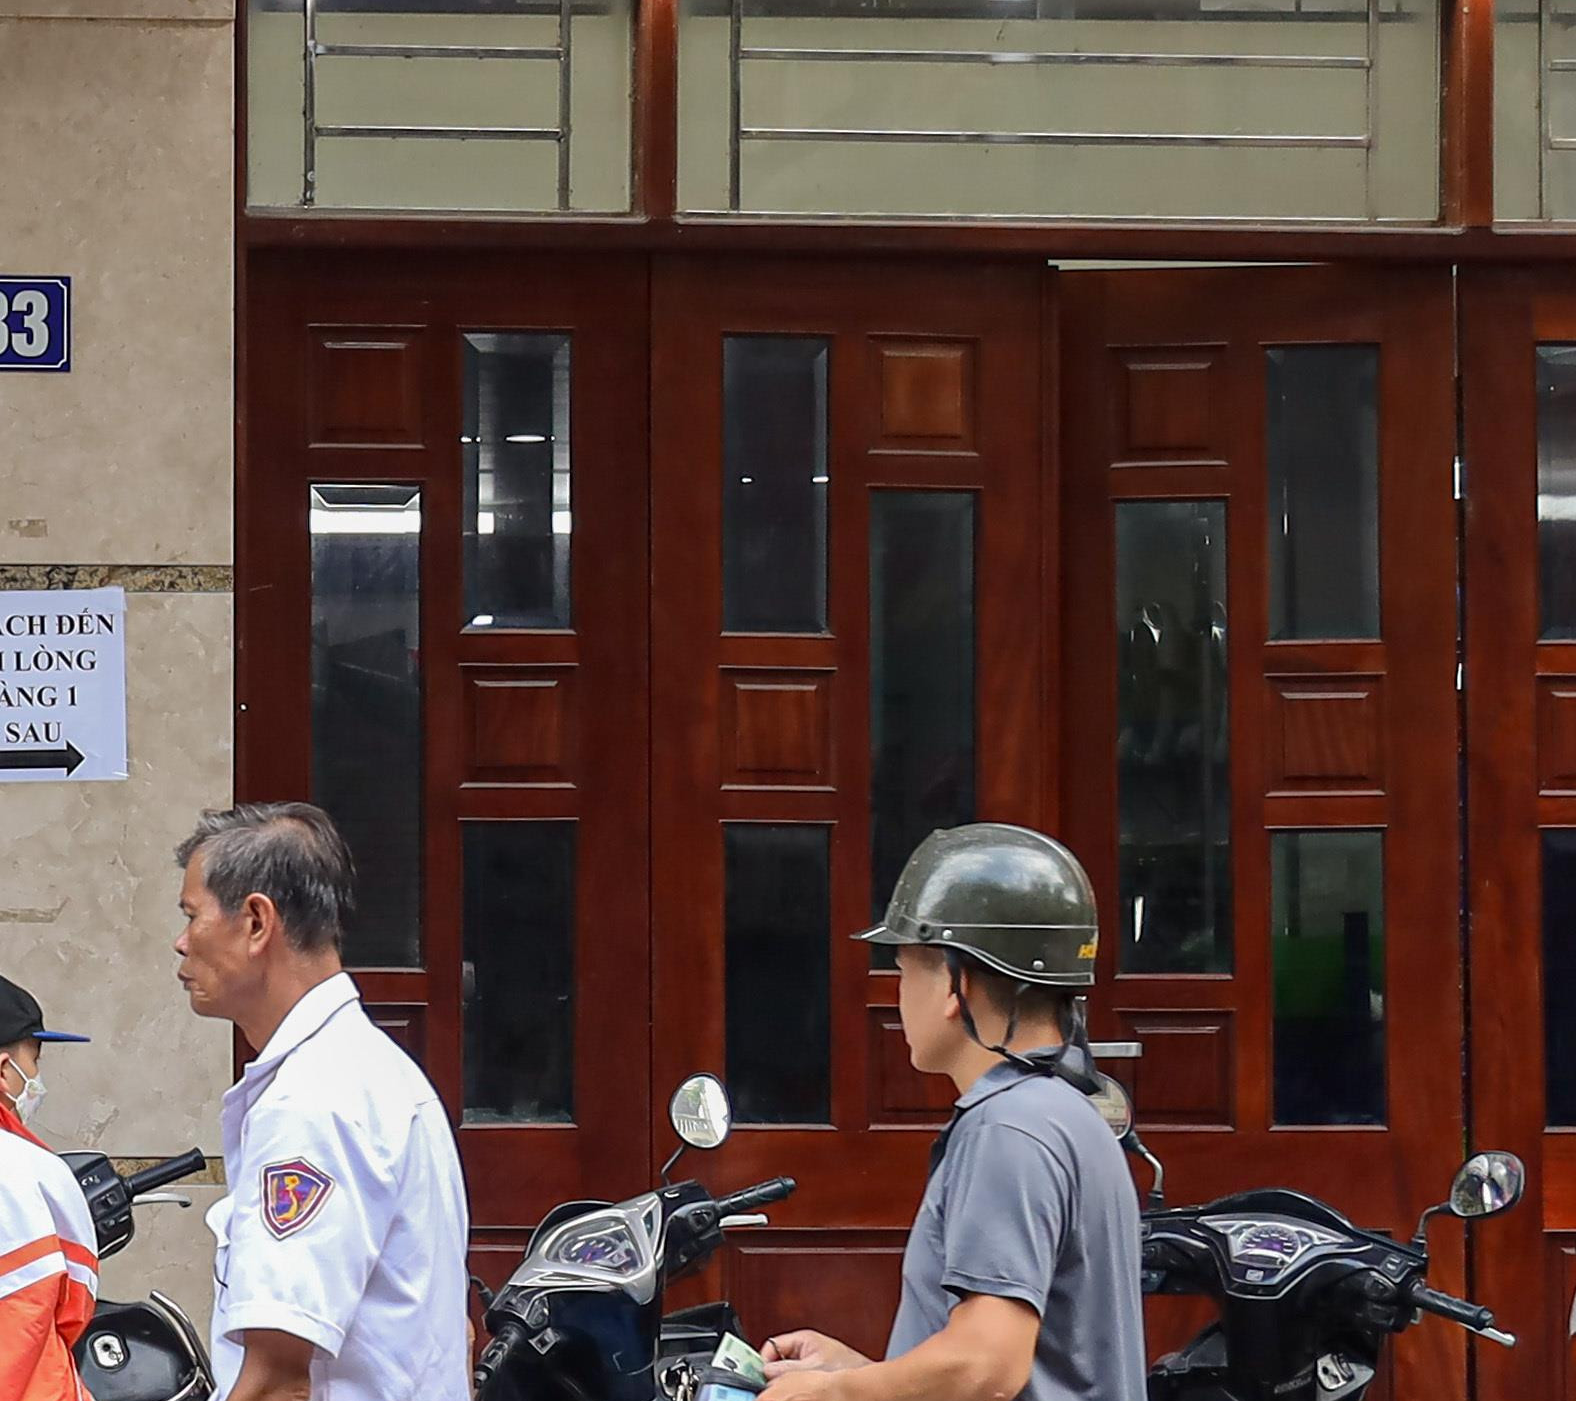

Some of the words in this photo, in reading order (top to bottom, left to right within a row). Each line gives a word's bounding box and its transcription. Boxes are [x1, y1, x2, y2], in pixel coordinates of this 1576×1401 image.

[56, 608, 116, 637] ĐẾN
[14, 643, 98, 673] LÒNG
[68, 685, 79, 708] 1
[5, 720, 64, 744] SAU
